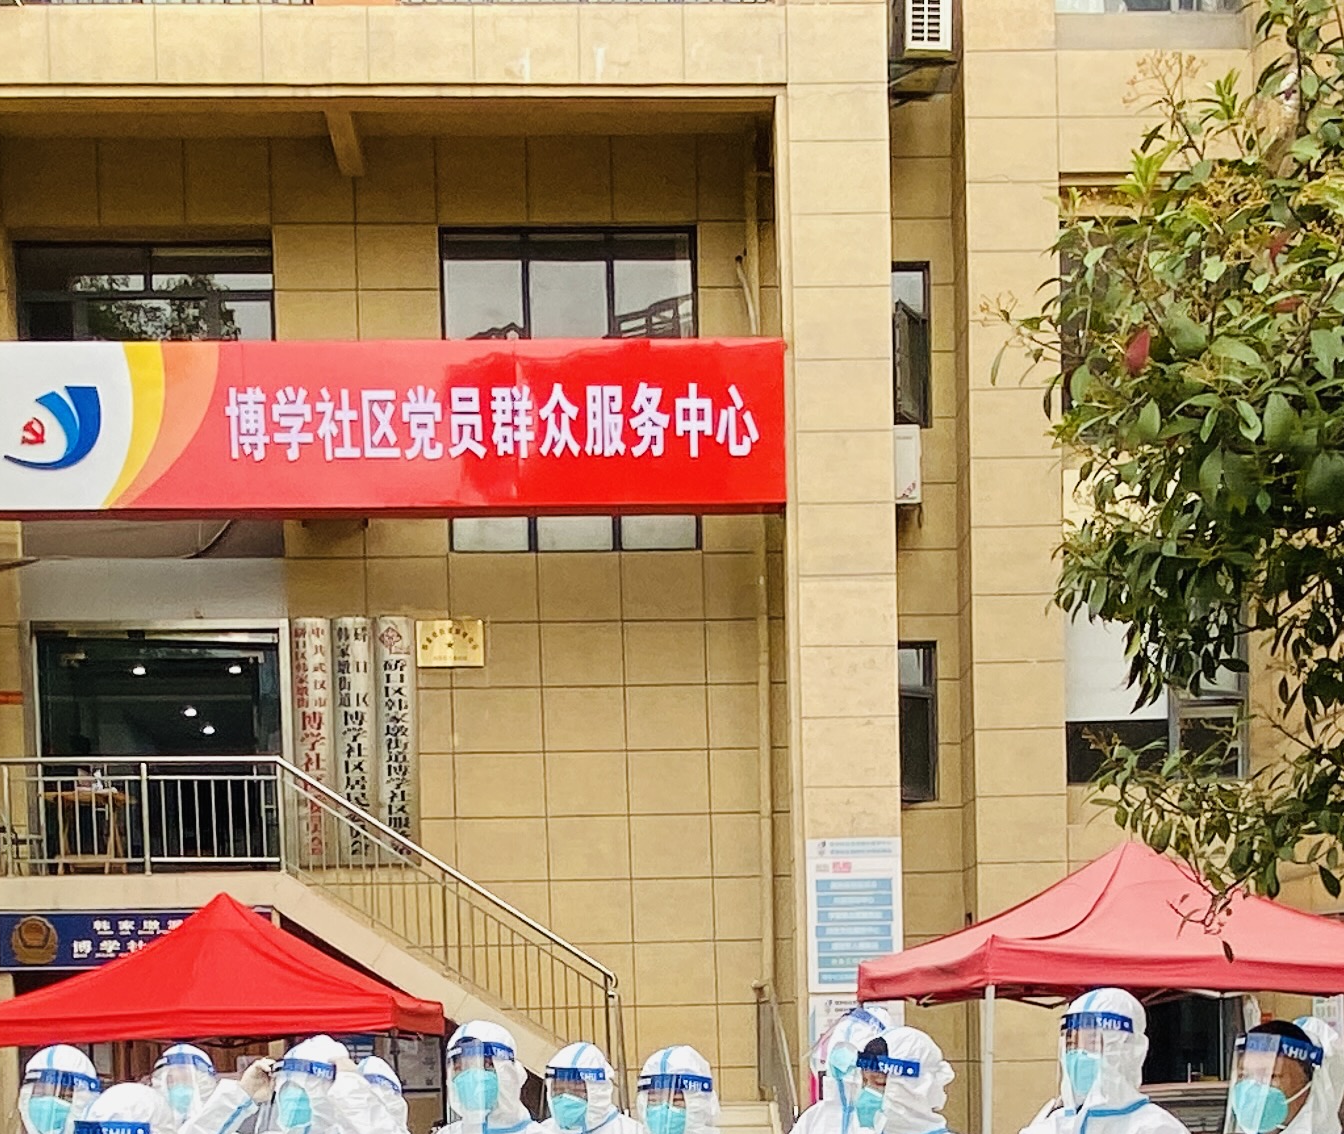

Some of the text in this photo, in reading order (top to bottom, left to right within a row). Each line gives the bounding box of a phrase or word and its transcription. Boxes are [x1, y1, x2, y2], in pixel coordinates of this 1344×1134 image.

[224, 382, 760, 463] 博学社区党员群众服务中心
